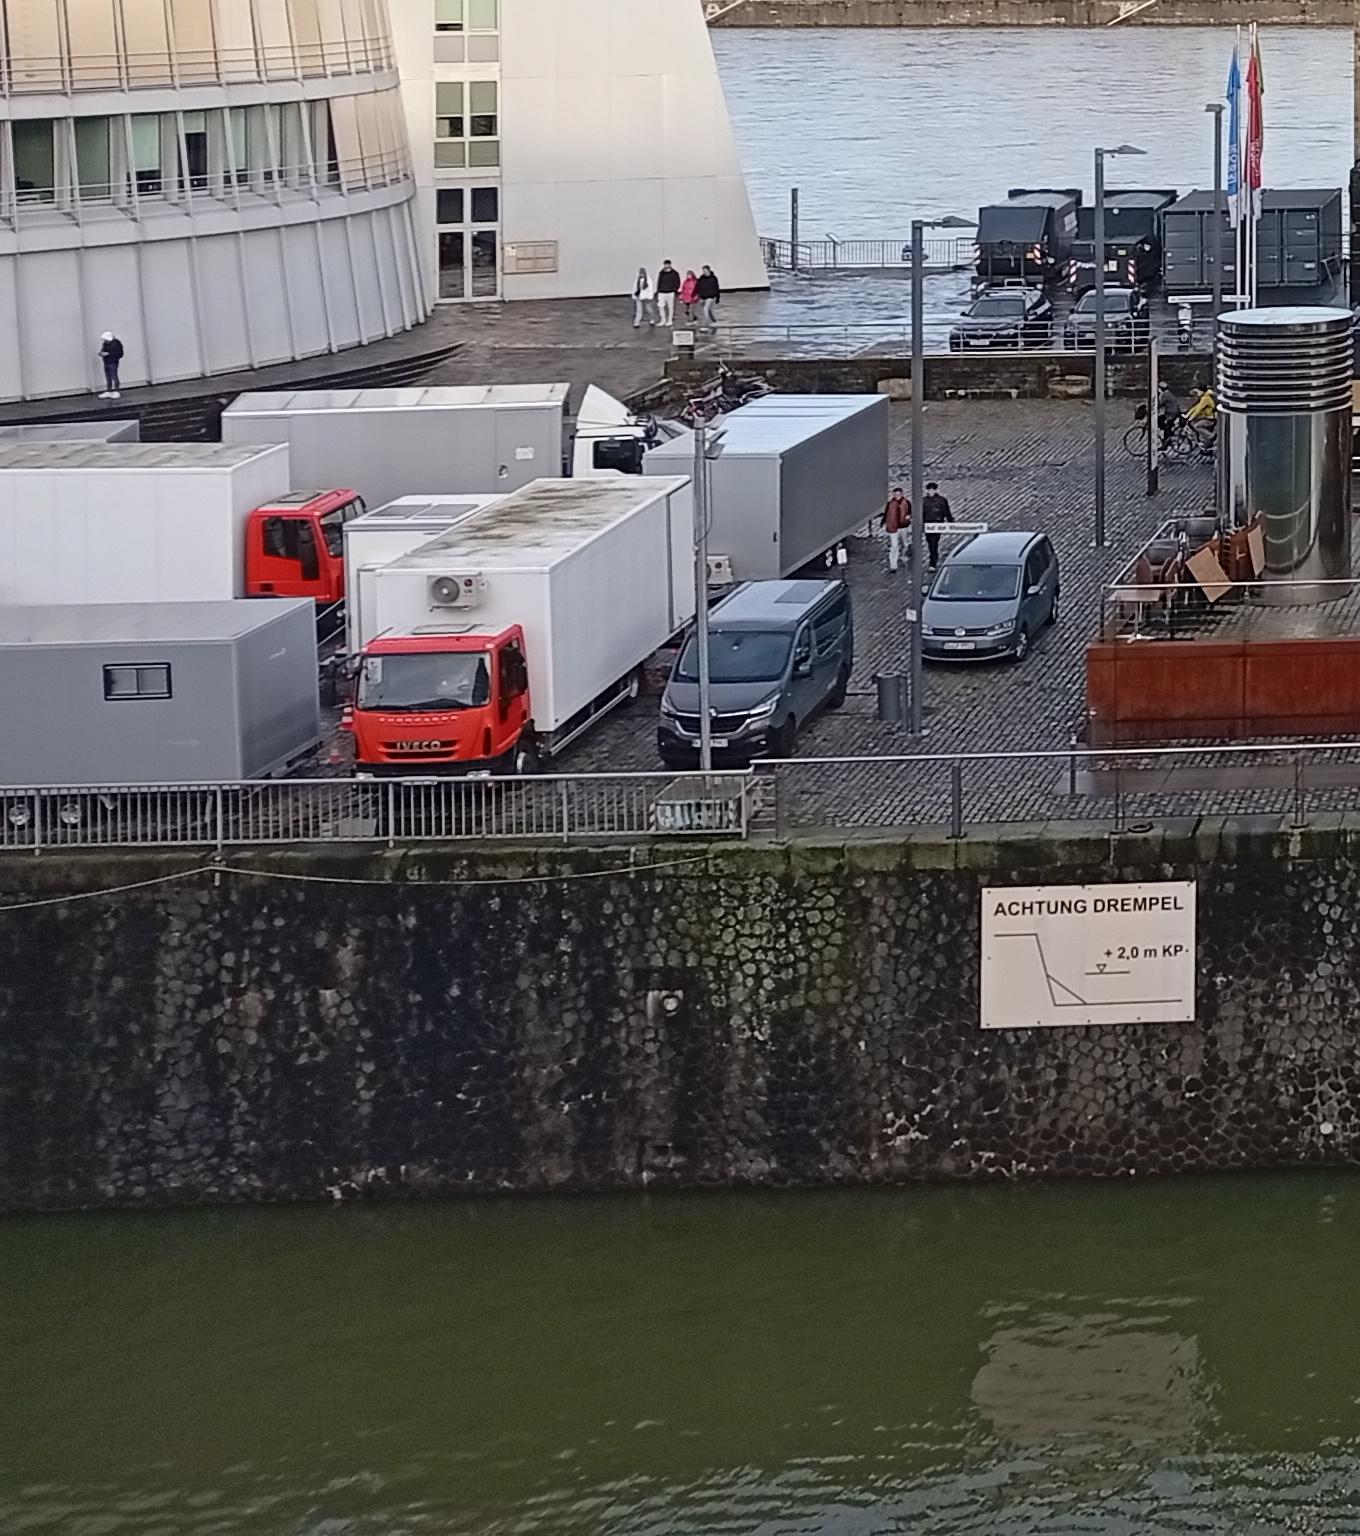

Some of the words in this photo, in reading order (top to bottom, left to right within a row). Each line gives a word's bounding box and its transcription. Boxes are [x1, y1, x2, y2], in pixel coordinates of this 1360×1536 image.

[395, 739, 441, 752] IVECO
[993, 899, 1087, 917] ACHTUNG
[1093, 896, 1184, 913] DREMPEL
[1104, 949, 1113, 958] +
[1117, 946, 1139, 961] 2,0
[1144, 948, 1157, 958] m
